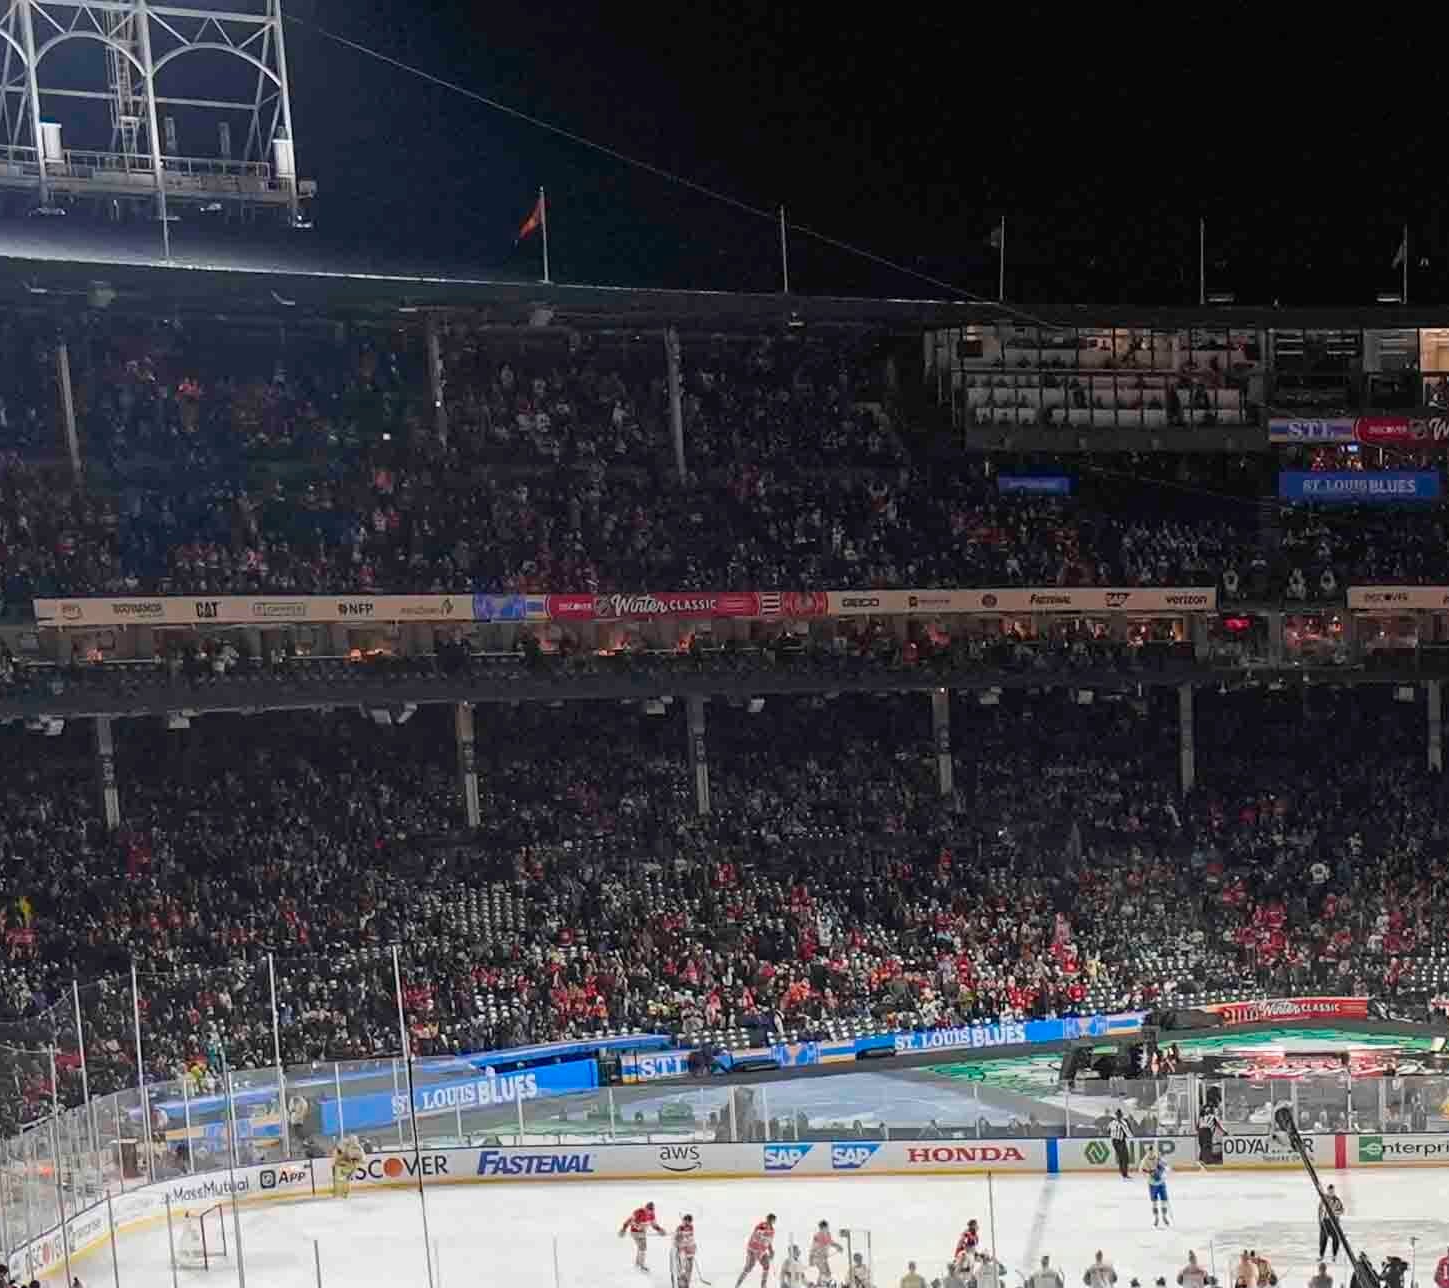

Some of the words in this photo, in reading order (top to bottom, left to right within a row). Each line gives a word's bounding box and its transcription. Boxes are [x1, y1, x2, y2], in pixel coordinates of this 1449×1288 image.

[196, 601, 218, 617] CAT
[669, 599, 717, 611] CLASSIC
[971, 1025, 1025, 1048] BLUES
[423, 1085, 475, 1111] LOUIS
[477, 1073, 538, 1106] BLUES
[659, 1147, 701, 1161] aws
[765, 1148, 802, 1166] SAP
[833, 1147, 871, 1164] SAP
[907, 1147, 1025, 1162] HONDA
[348, 1155, 447, 1182] SCOVER
[477, 1151, 594, 1175] FASTENAL
